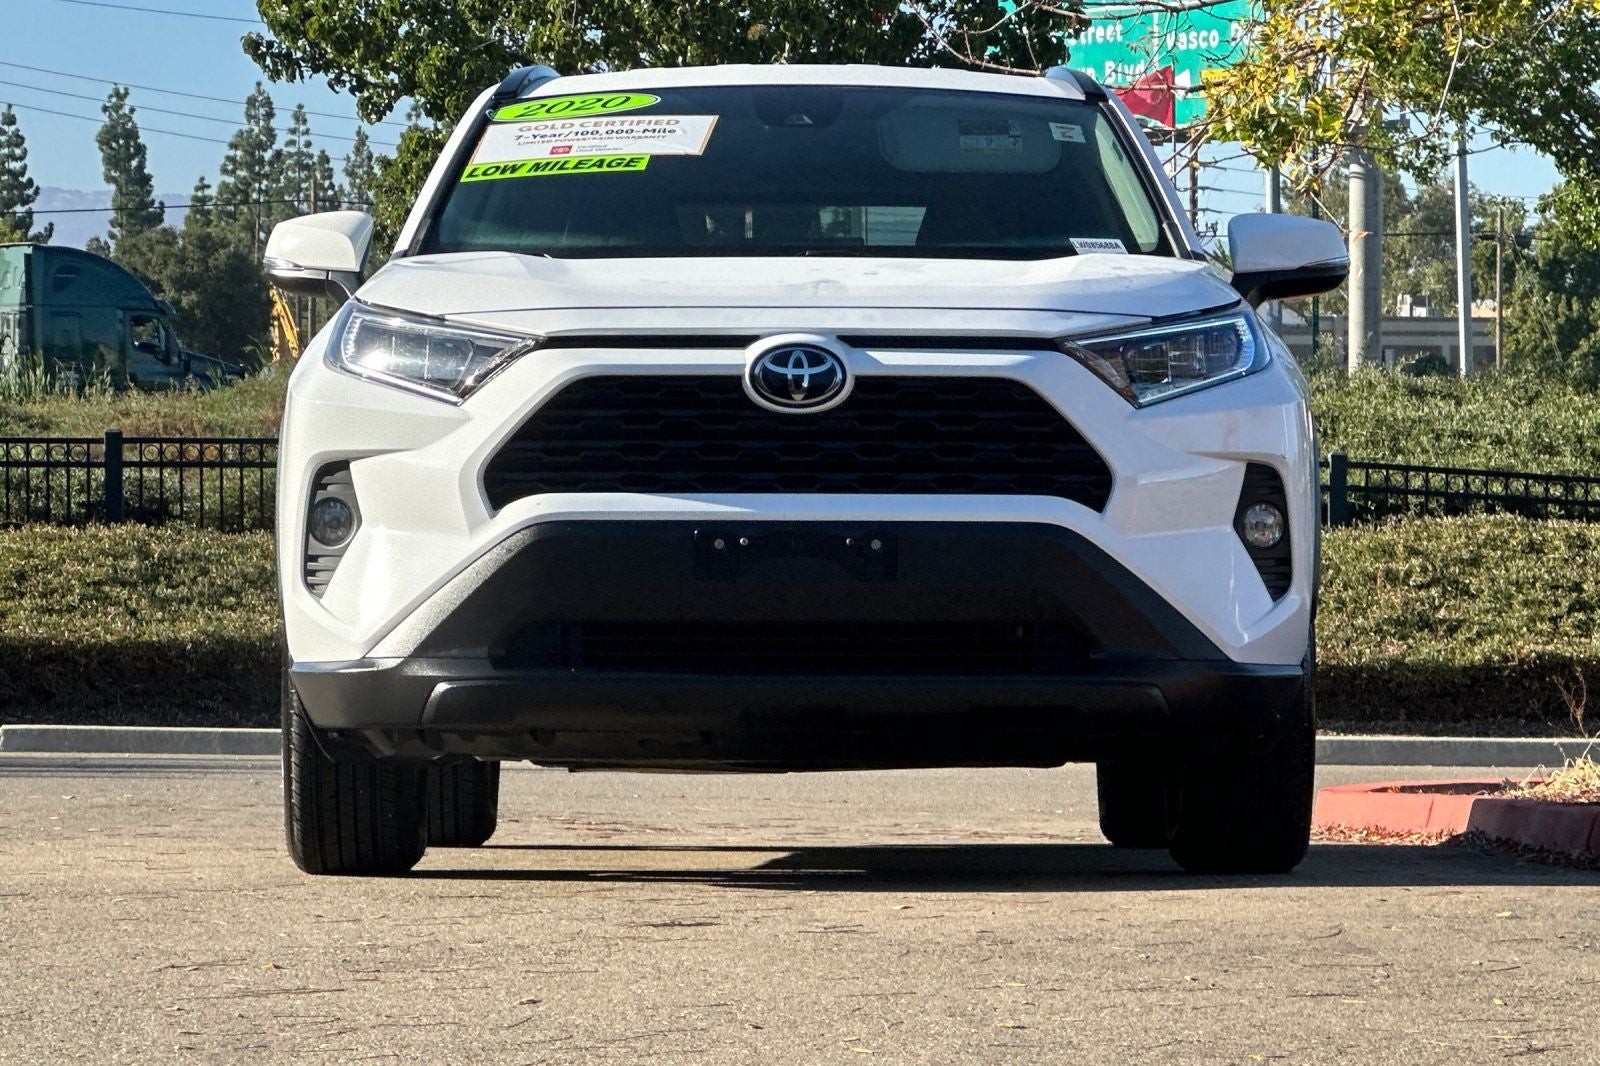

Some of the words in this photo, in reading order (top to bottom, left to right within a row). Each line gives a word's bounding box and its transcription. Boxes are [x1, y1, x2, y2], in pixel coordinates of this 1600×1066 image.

[1166, 28, 1220, 51] Vasco
[1104, 60, 1145, 85] Blvd
[516, 95, 631, 119] 2020
[514, 127, 677, 141] 7-Year/100,000-Mile
[518, 122, 575, 133] GOLD
[579, 119, 681, 128] CERTIFIED
[554, 135, 614, 143] POWERTRAIN
[465, 163, 524, 178] LOW
[526, 157, 641, 173] MILEAGE
